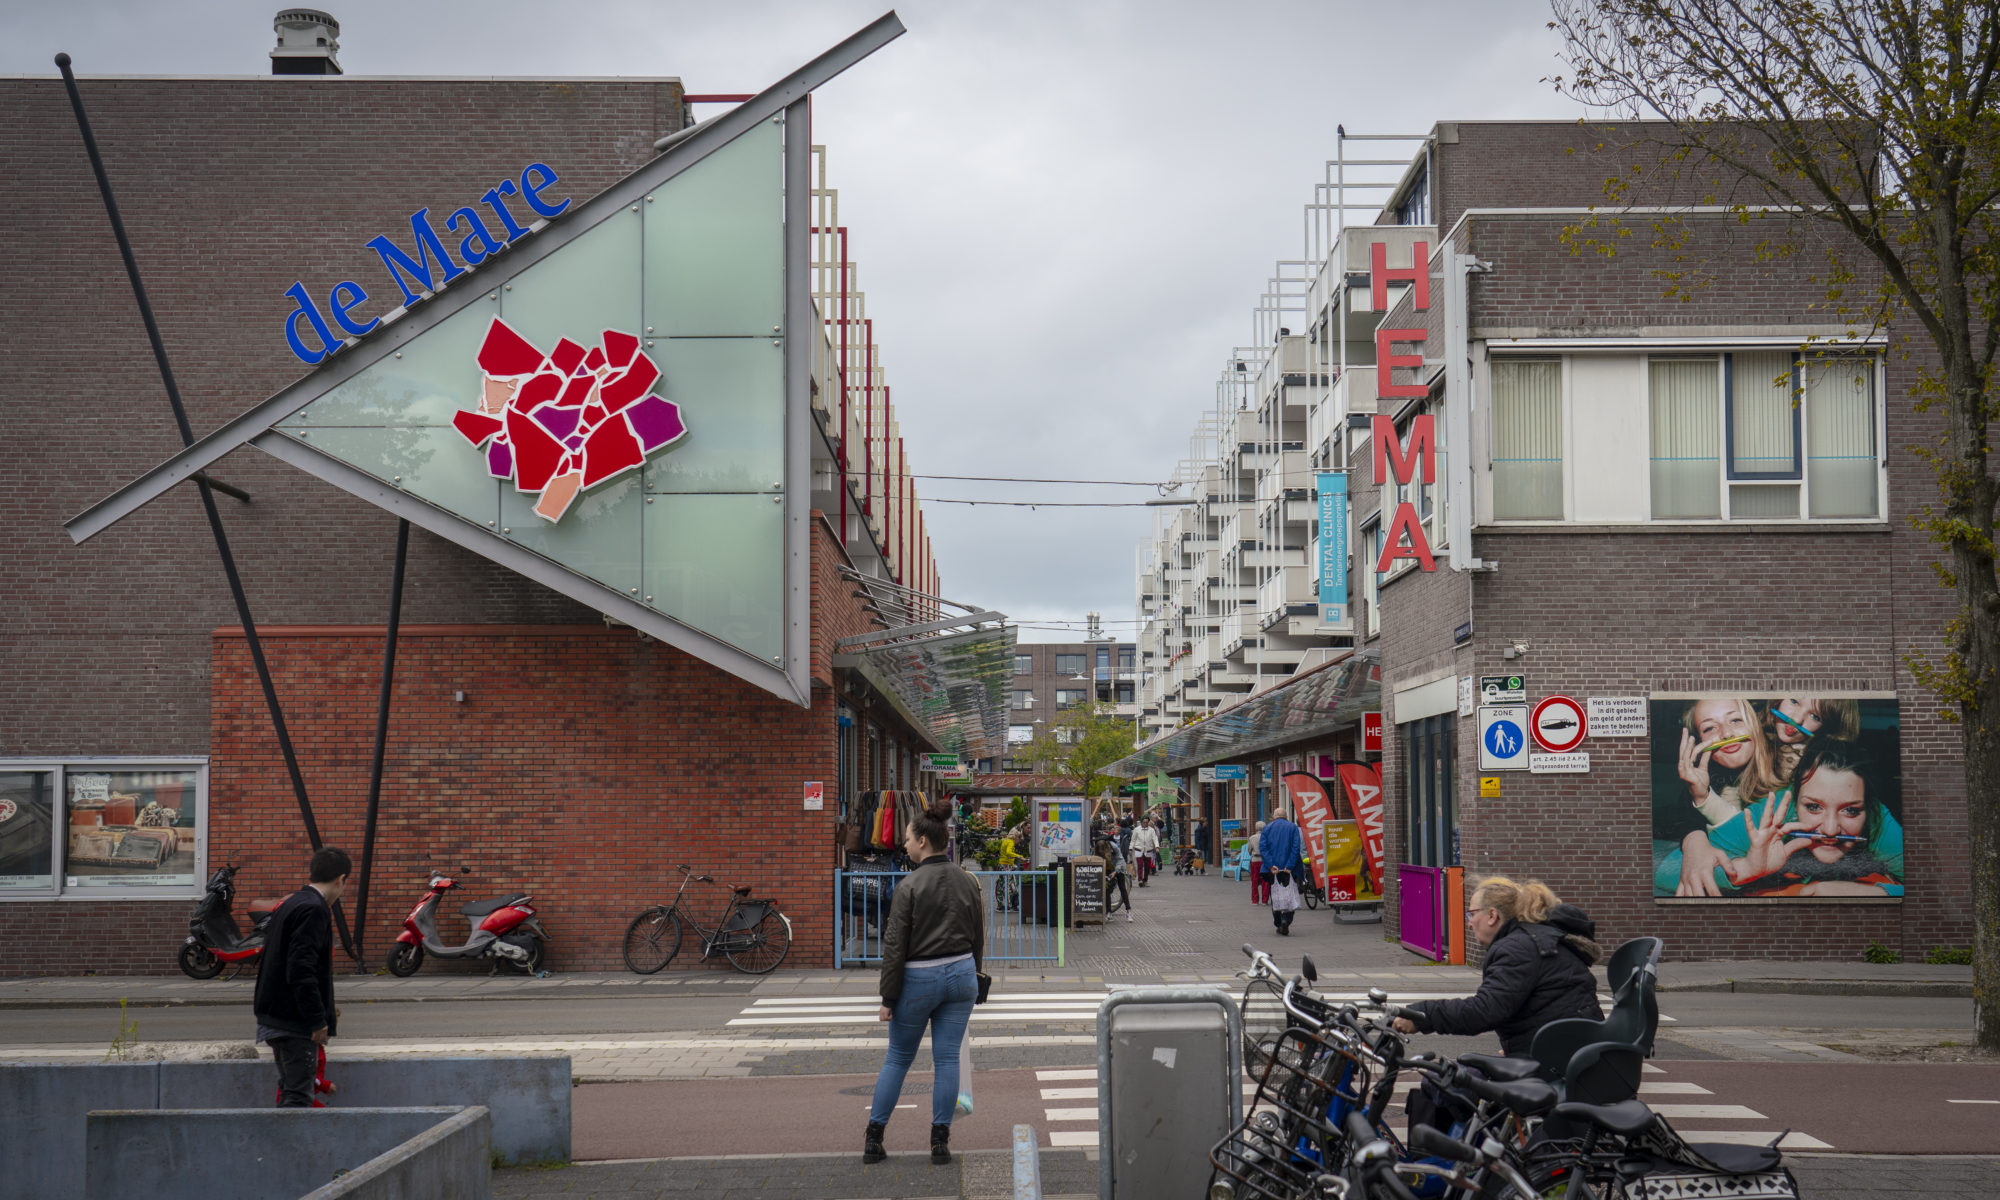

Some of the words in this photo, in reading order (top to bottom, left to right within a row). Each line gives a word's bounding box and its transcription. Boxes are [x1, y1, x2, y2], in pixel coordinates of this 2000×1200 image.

[284, 281, 380, 364] de
[366, 162, 572, 309] Mare
[1369, 241, 1437, 573] HEMA
[1323, 491, 1333, 538] CLINICS
[1323, 540, 1334, 588] DENTAL
[1600, 715, 1614, 723] geld
[1616, 707, 1638, 715] gebied
